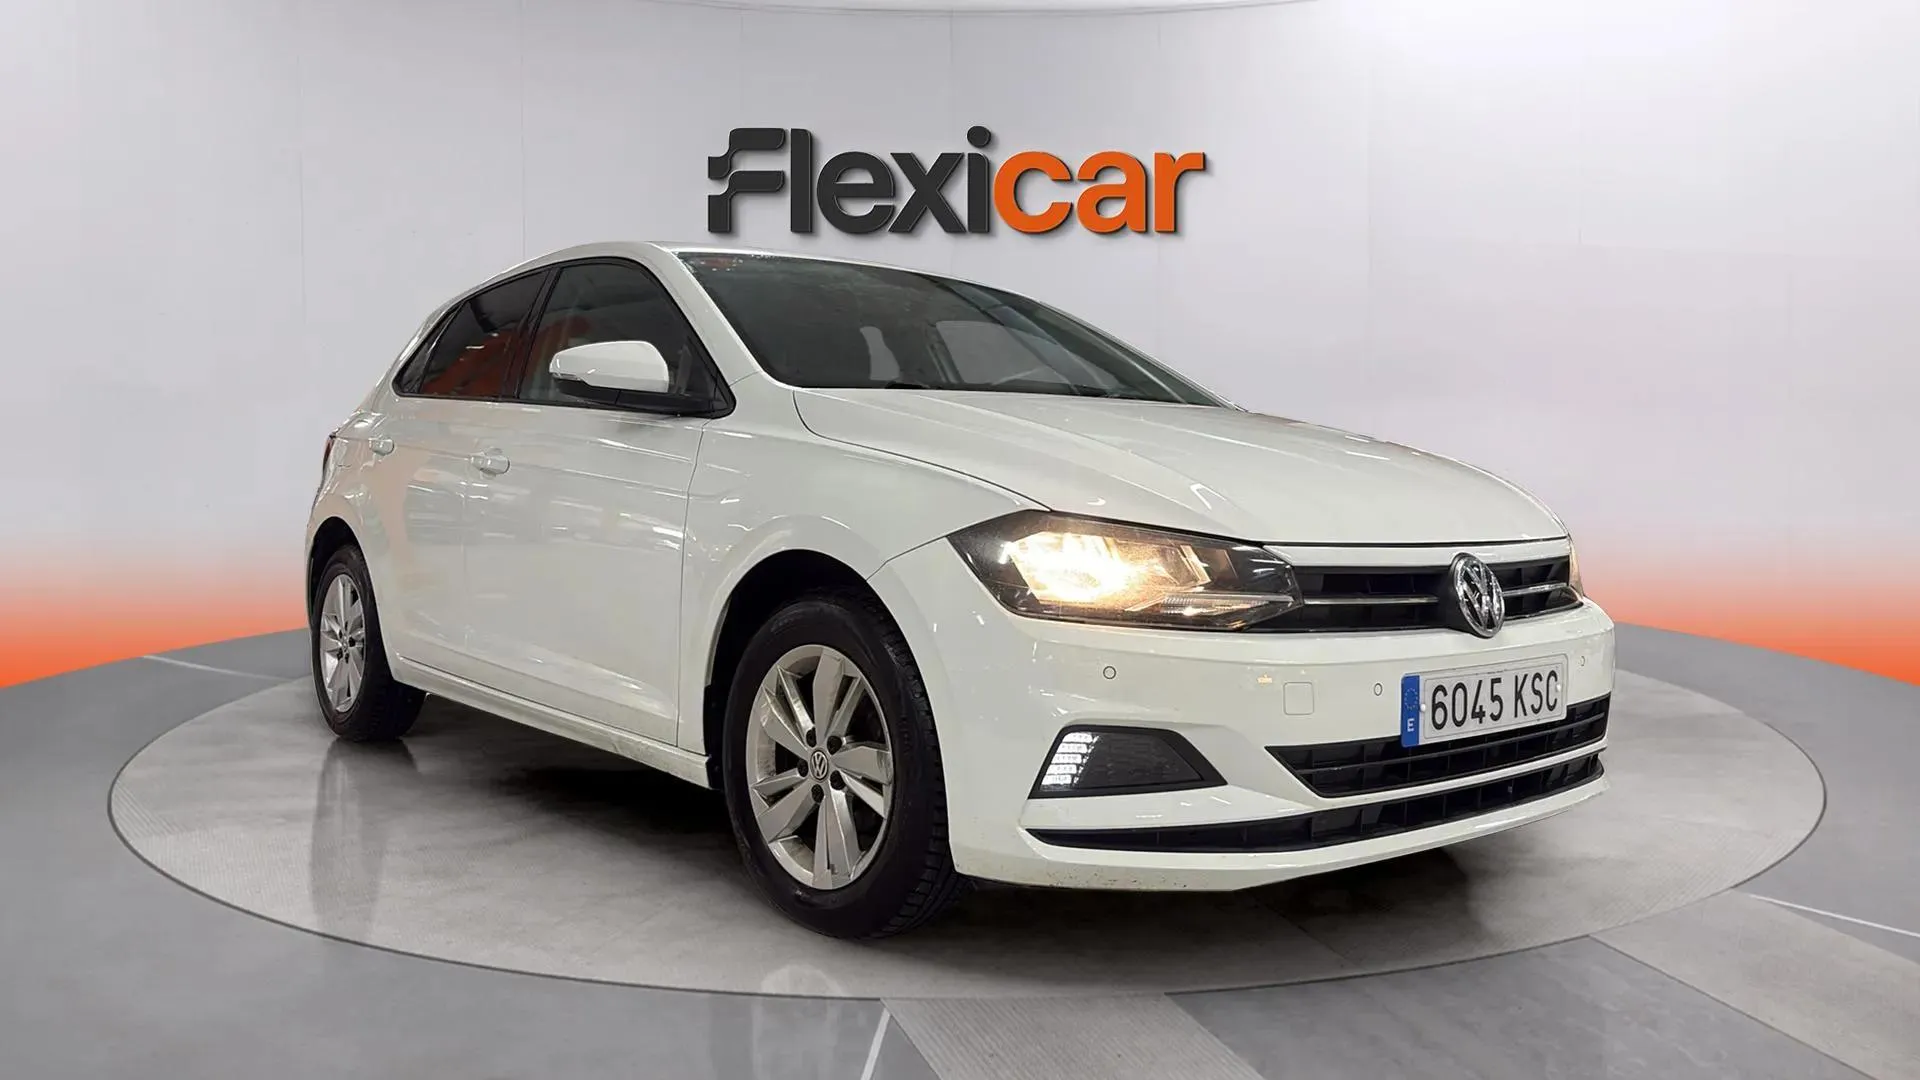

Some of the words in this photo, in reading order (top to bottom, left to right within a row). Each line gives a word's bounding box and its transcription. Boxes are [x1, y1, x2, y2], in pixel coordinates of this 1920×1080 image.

[708, 126, 1205, 233] Flexicar
[1407, 718, 1414, 732] E
[1431, 677, 1504, 730] 6045
[1514, 670, 1558, 718] KSC
